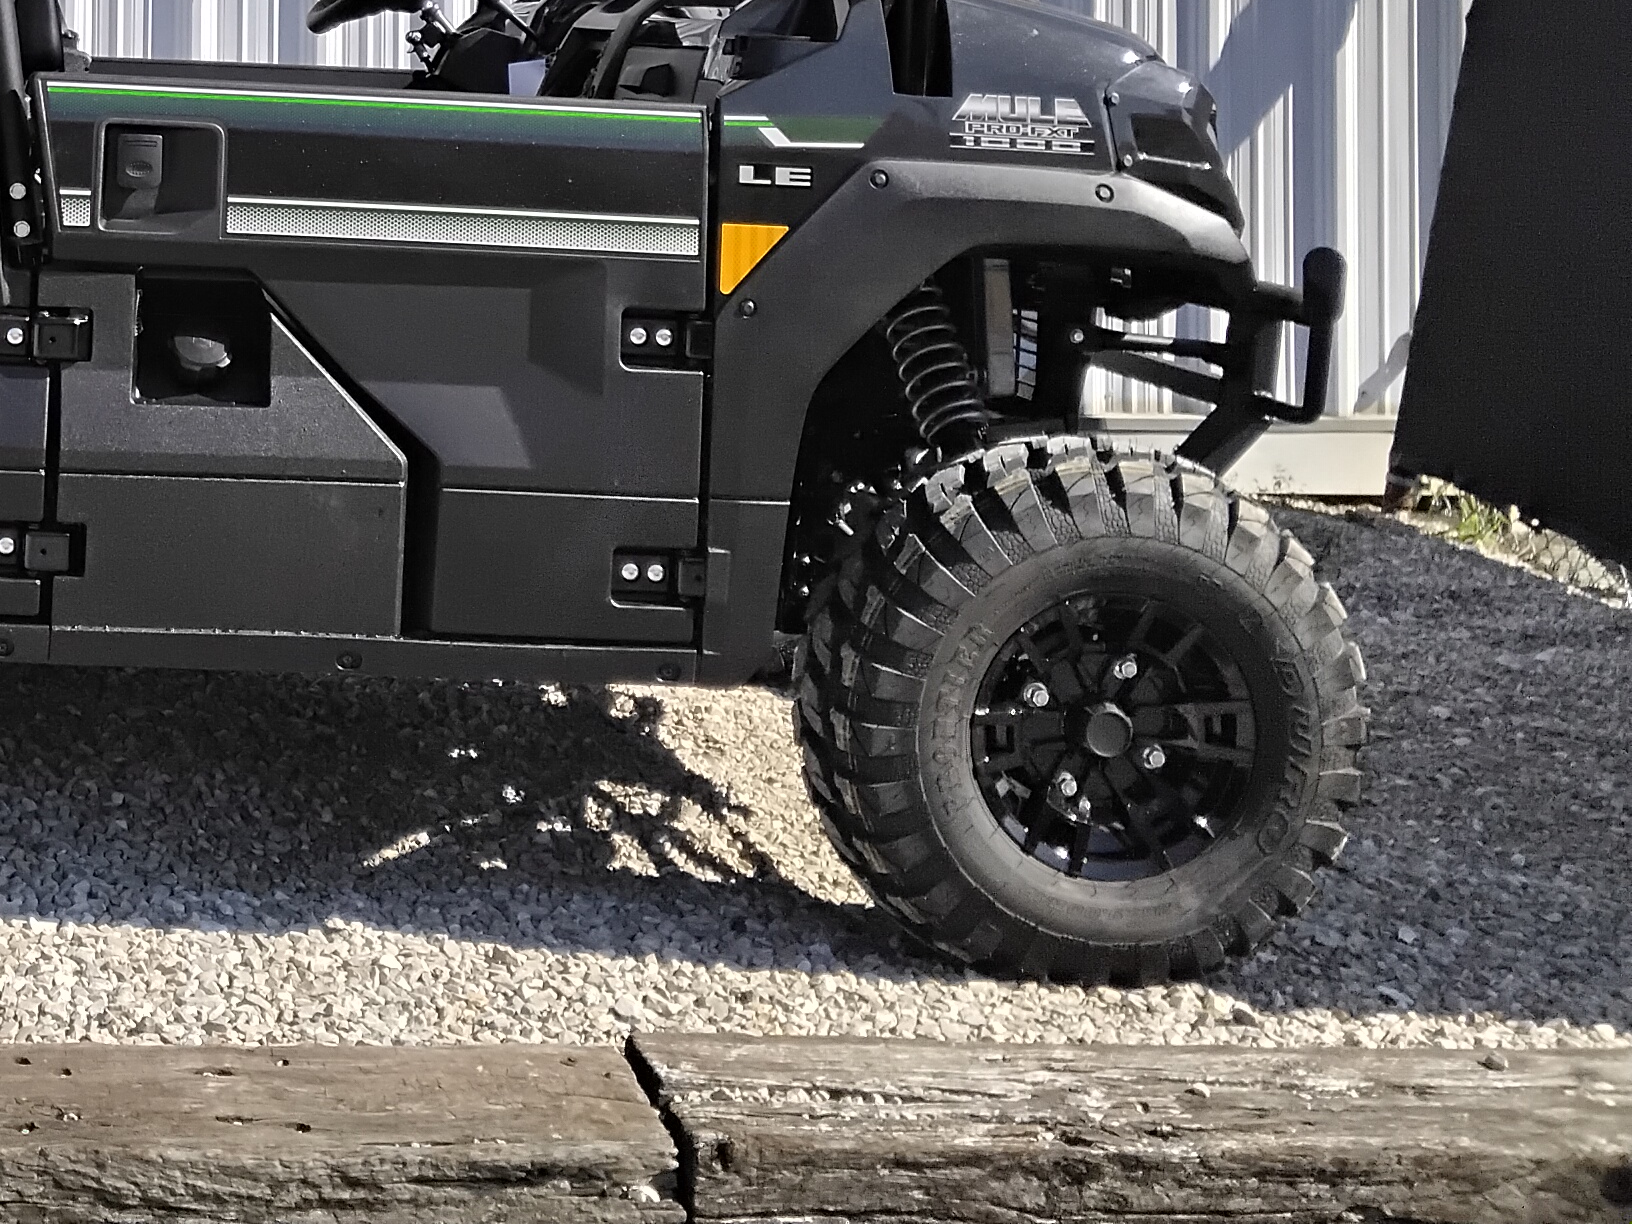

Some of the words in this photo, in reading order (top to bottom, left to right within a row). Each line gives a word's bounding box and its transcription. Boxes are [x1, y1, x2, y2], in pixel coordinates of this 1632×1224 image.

[952, 93, 1092, 127] MULE
[963, 136, 1081, 152] 1000
[739, 165, 811, 187] LE
[1256, 656, 1314, 857] DURO
